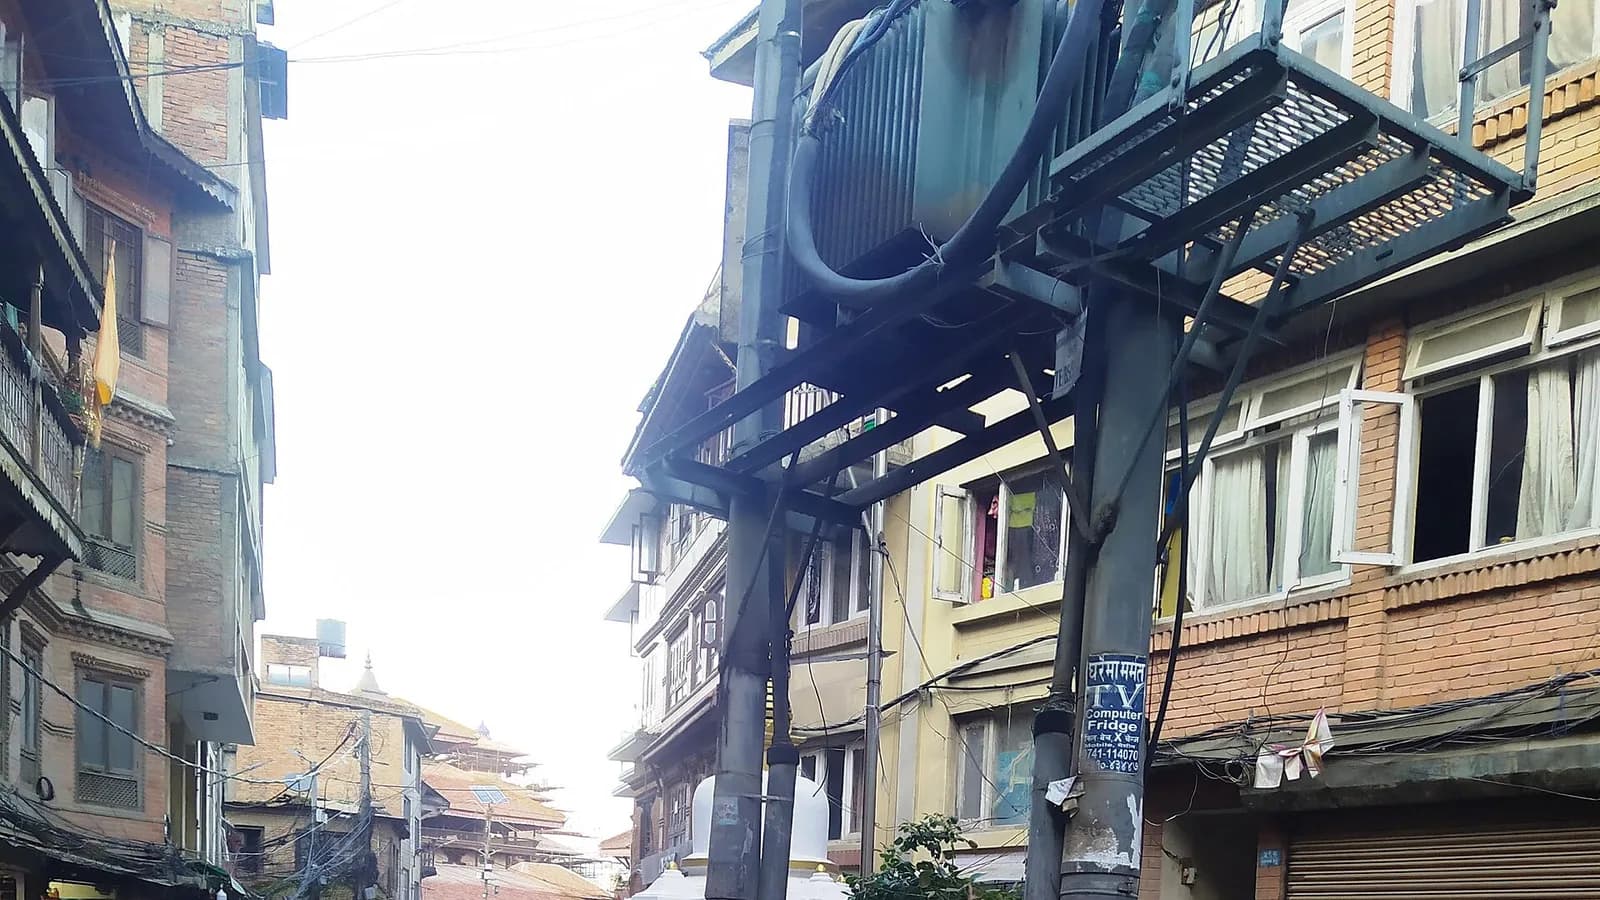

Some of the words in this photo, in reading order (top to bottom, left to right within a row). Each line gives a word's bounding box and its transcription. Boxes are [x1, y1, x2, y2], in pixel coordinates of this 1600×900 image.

[1087, 708, 1142, 721] Computer
[1088, 720, 1138, 733] Fridge
[1083, 748, 1139, 761] 741-114070
